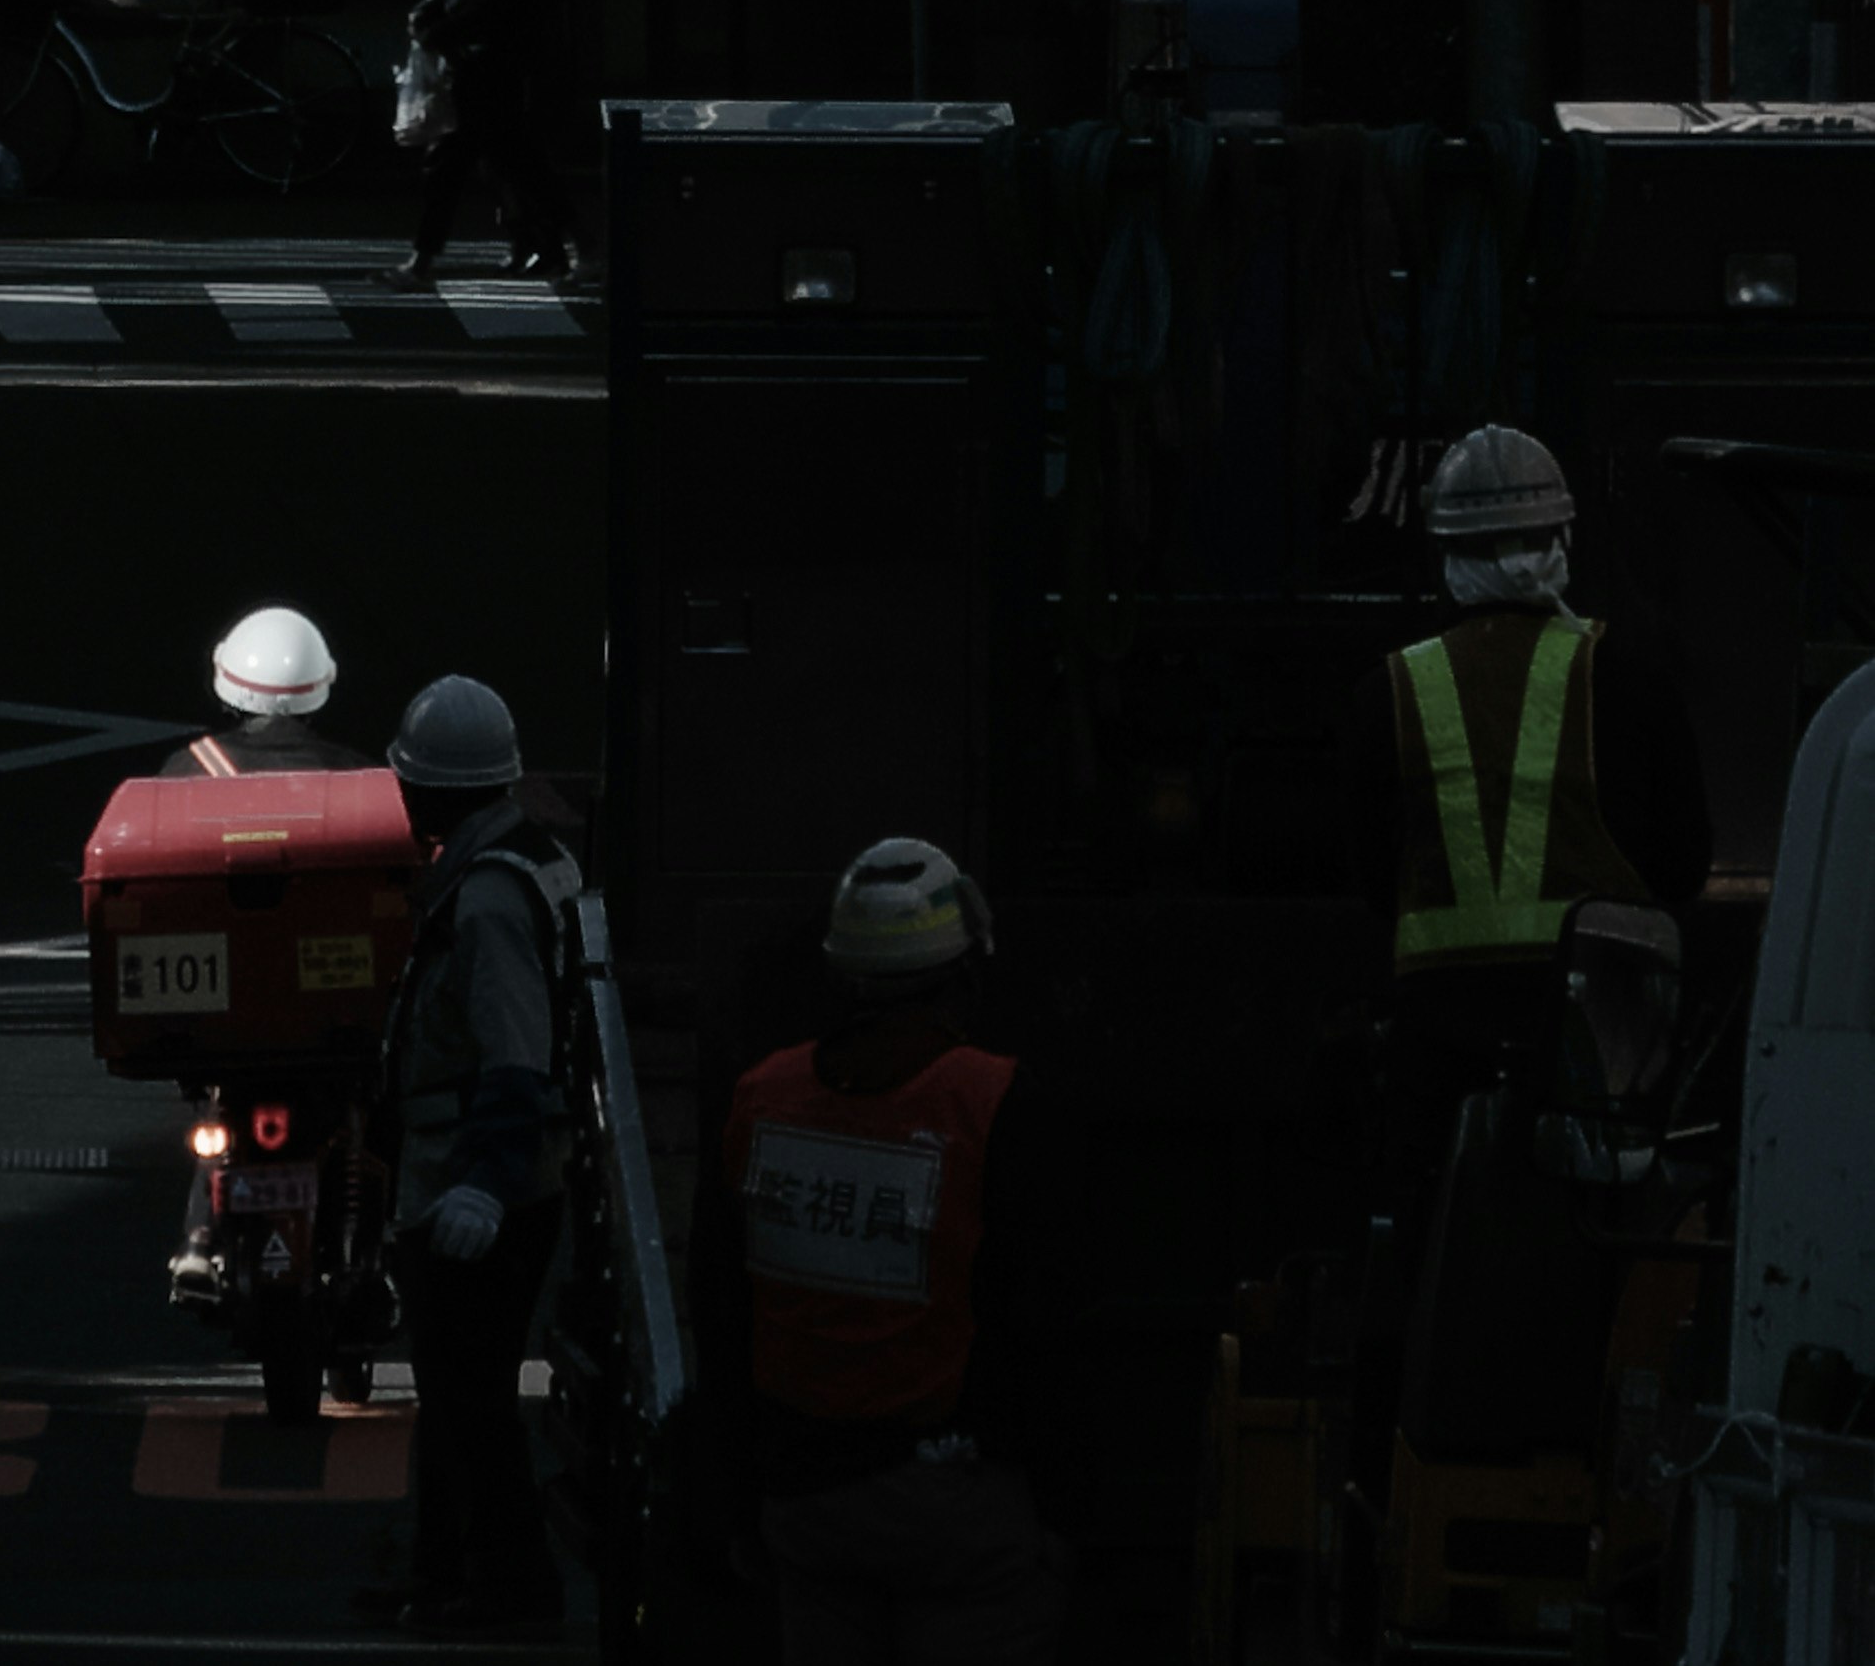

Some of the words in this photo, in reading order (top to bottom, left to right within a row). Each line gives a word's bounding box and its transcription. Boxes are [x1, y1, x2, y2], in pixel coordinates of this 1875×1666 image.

[153, 953, 217, 994] 101
[754, 1169, 911, 1245] 監視員
